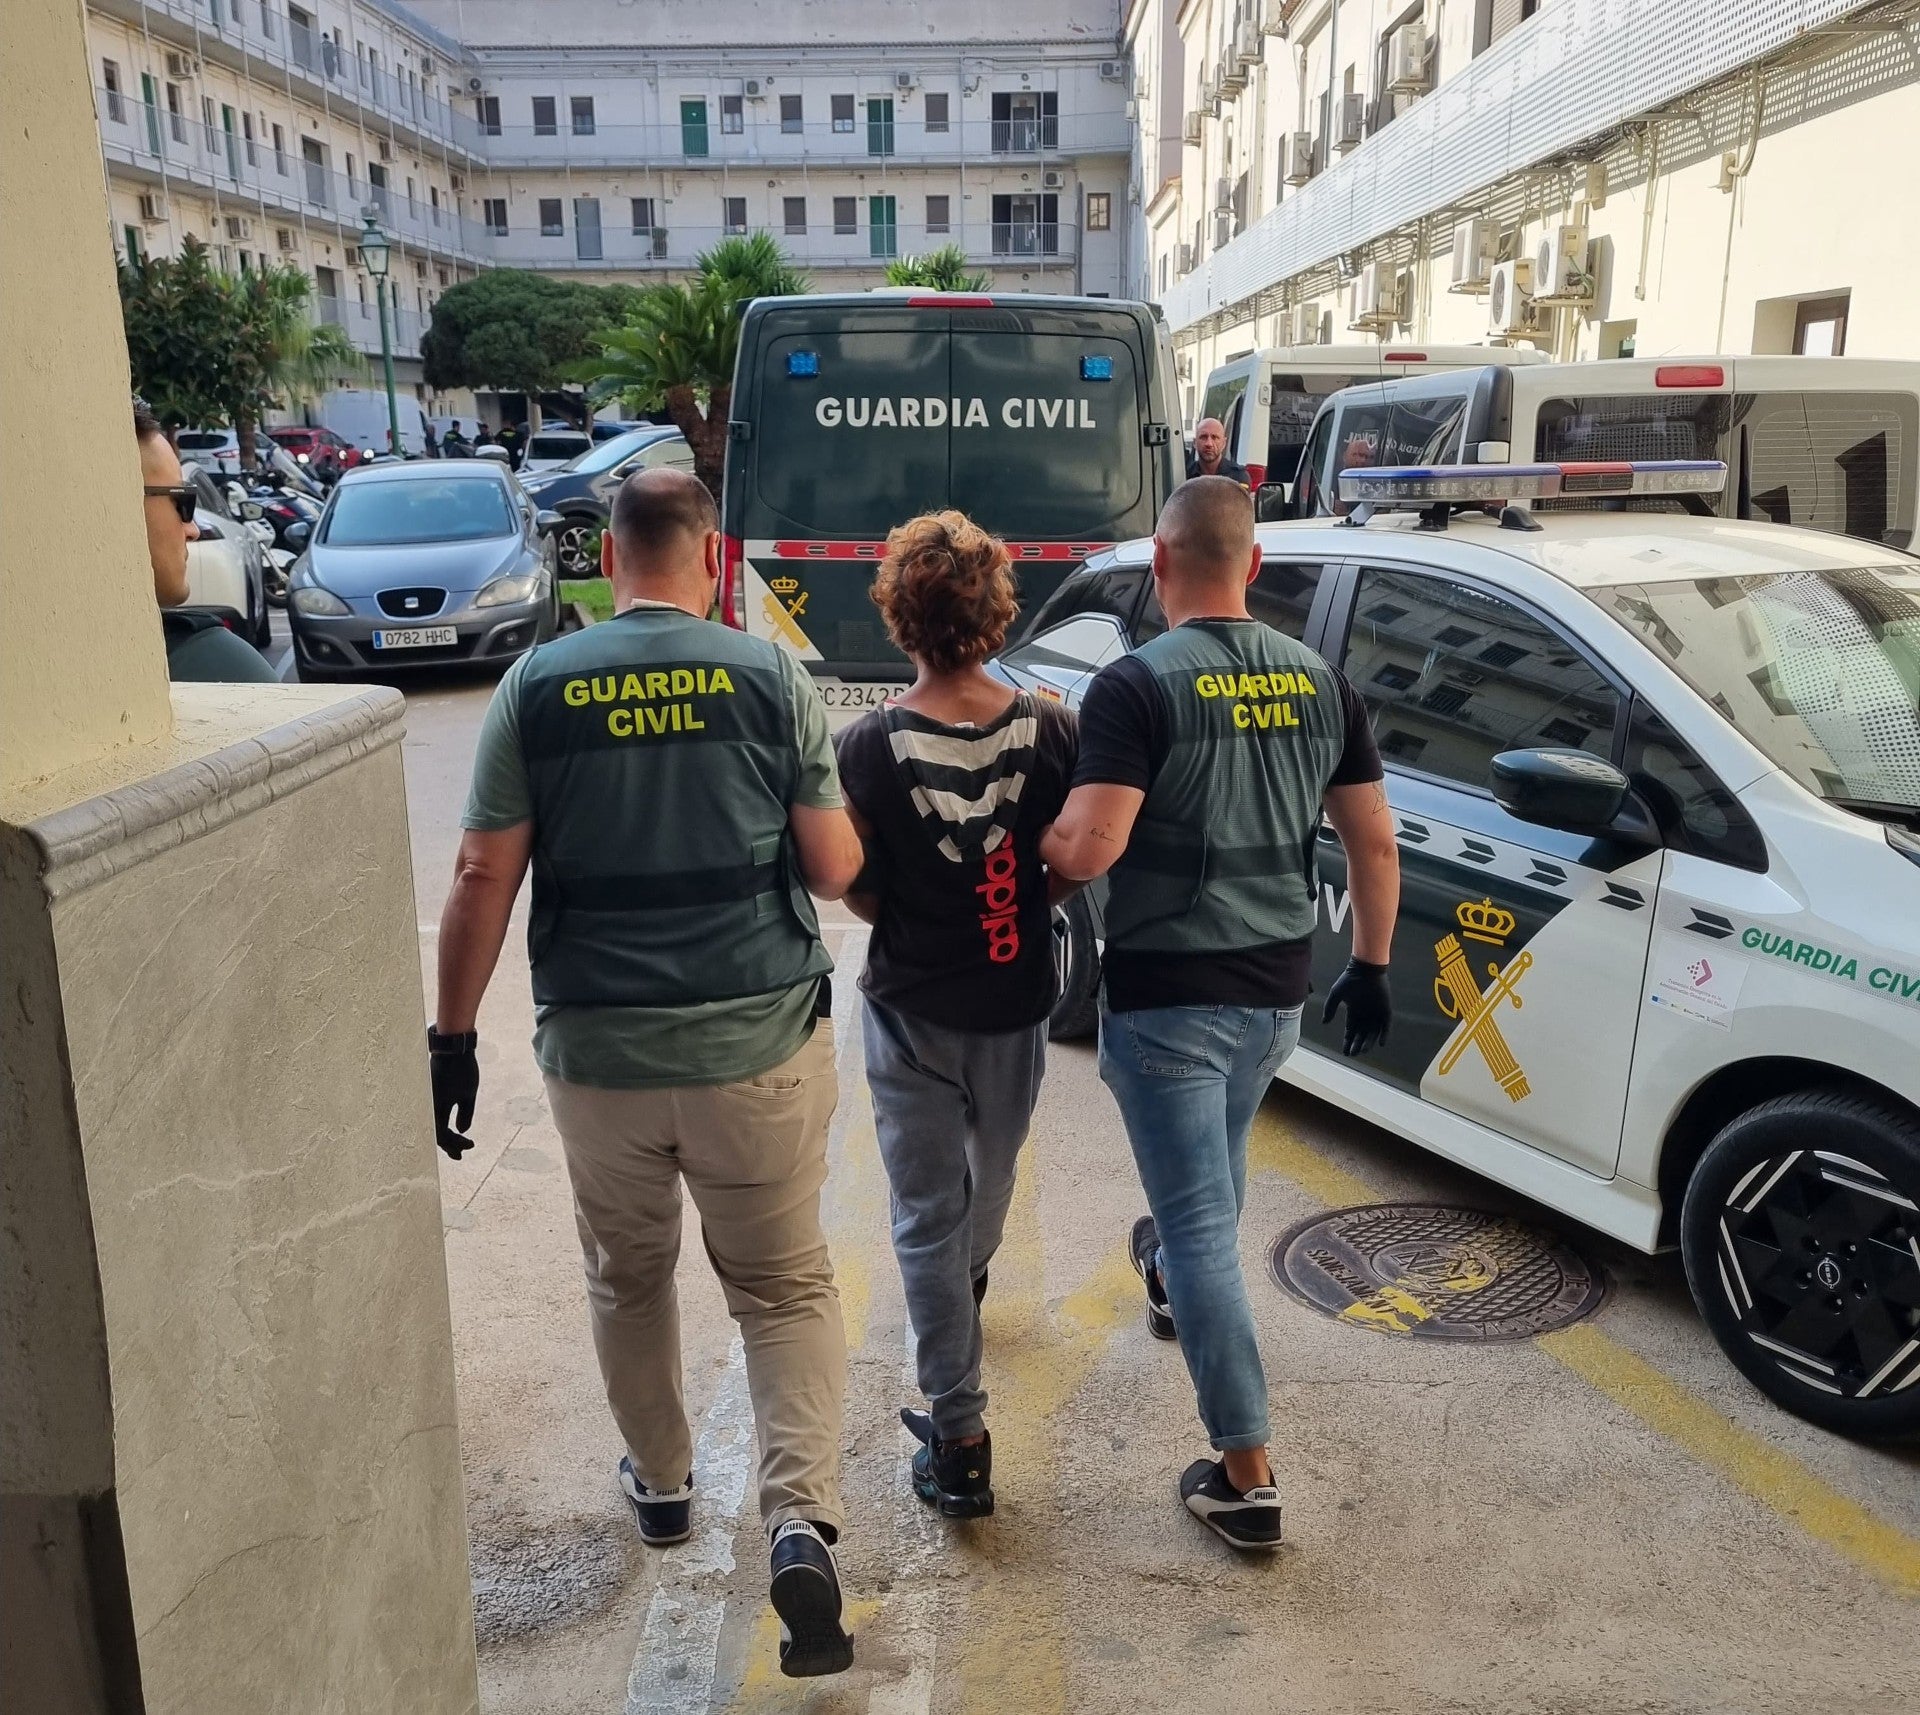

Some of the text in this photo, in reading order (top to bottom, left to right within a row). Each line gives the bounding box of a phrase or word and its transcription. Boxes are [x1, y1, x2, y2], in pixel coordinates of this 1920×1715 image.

[815, 397, 1096, 428] GUARDIA CIVIL
[385, 629, 452, 645] 0782 HHC
[563, 668, 735, 706] GUARDIA
[840, 687, 889, 706] 2342
[1196, 672, 1317, 698] GUARDIA
[607, 703, 705, 737] CIVIL
[1741, 927, 1858, 981] GUARDIA
[1254, 1491, 1277, 1500] PUMA
[783, 1523, 811, 1533] PUMA
